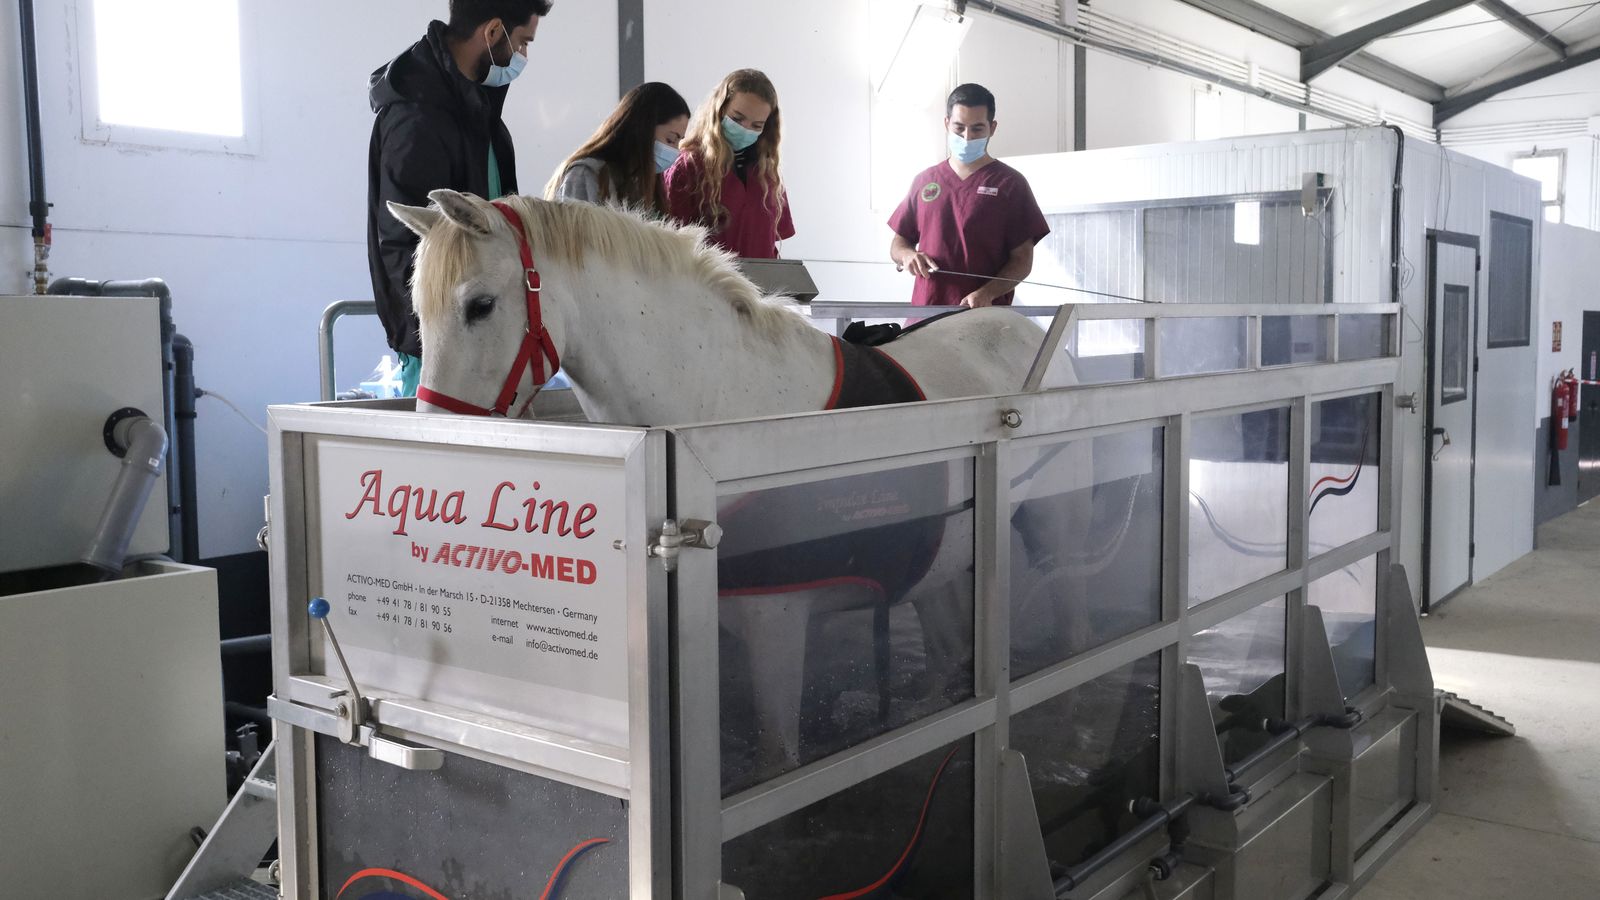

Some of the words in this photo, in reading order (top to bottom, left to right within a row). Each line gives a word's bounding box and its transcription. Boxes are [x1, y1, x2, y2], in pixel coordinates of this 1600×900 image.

[345, 469, 467, 536] Aqua
[481, 481, 598, 539] Line
[411, 541, 429, 563] by
[432, 542, 598, 585] ACTIVO-MED
[346, 573, 391, 589] ACTIVO-MED
[392, 580, 413, 592] GmbH
[419, 585, 426, 594] In
[427, 586, 438, 596] der
[440, 588, 464, 601] Marsch
[466, 592, 474, 602] 15
[480, 594, 511, 608] D-21358
[513, 599, 555, 616] Mechtersen
[562, 607, 598, 625] Germany
[347, 592, 367, 603] phone
[376, 597, 390, 606] +49
[392, 599, 400, 608] 41
[403, 600, 412, 610] 78
[420, 602, 428, 612] 81
[431, 604, 440, 615] 90
[443, 606, 452, 617] 55
[348, 606, 358, 616] fax
[376, 612, 390, 621] +49
[392, 614, 400, 624] 41
[403, 616, 412, 626] 78
[420, 619, 428, 629] 81
[431, 621, 440, 631] 90
[443, 623, 452, 633] 56
[490, 615, 519, 629] internet
[526, 622, 598, 642] www.activomed.de
[491, 633, 514, 645] e-mail
[526, 638, 598, 660] info@activomed.de
